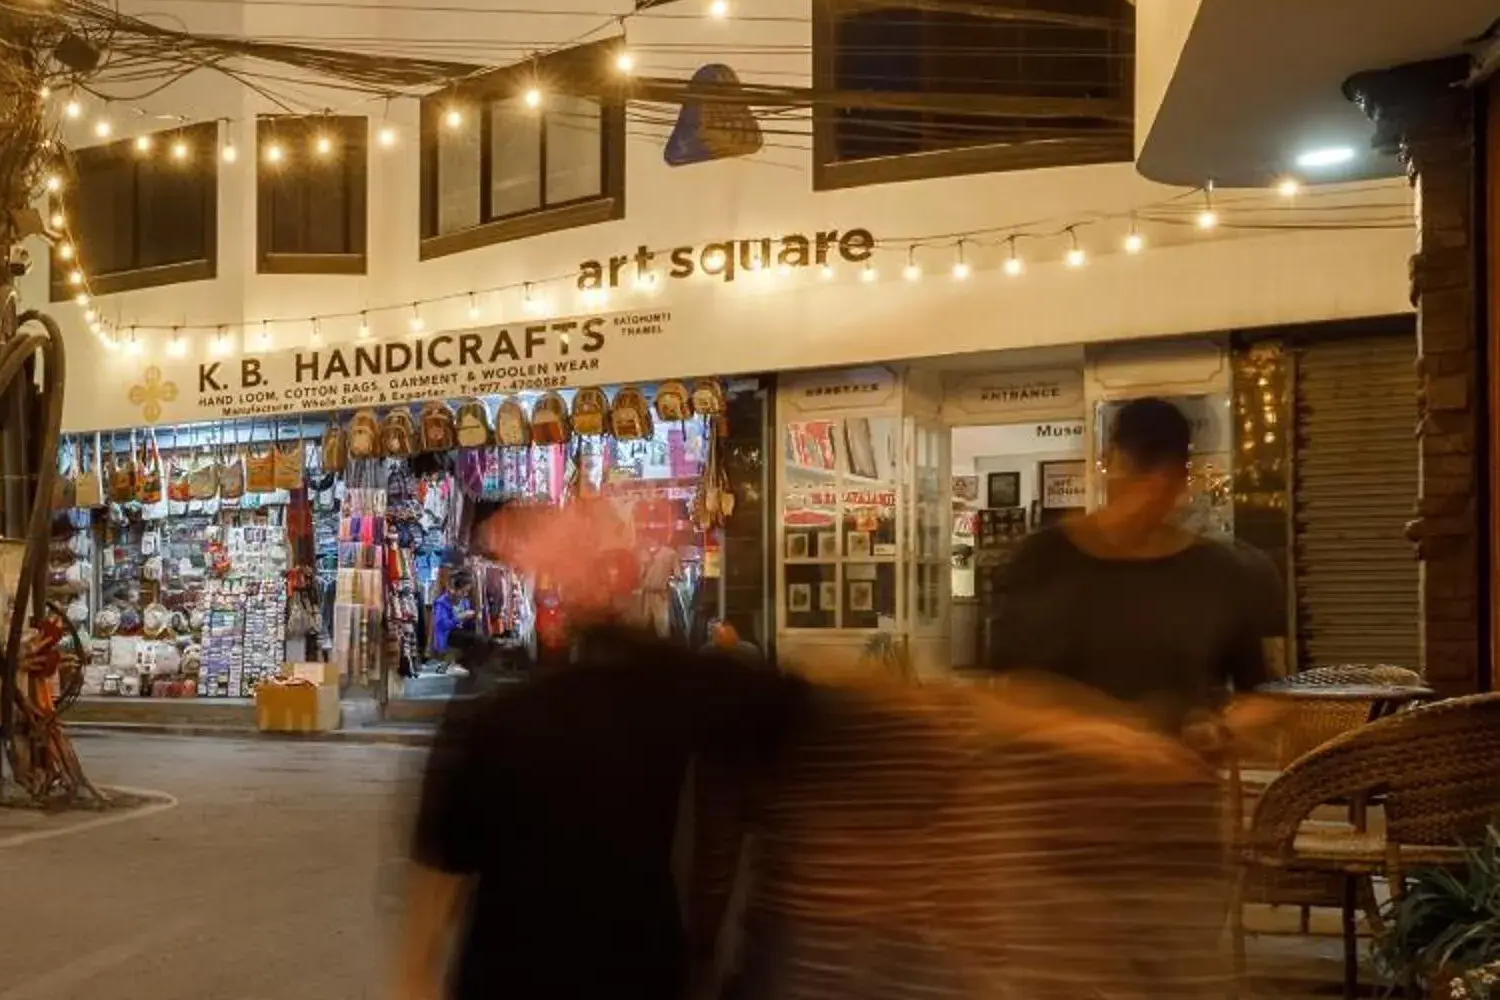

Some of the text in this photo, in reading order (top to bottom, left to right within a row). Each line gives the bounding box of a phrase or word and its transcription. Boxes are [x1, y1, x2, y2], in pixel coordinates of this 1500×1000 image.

[577, 228, 875, 291] art square
[199, 318, 606, 393] K. B. HANDICRAFTS
[199, 395, 233, 407] HAND
[284, 385, 337, 400] COTTON
[389, 373, 458, 389] GARMENT
[467, 371, 477, 382] &
[482, 363, 549, 381] WOOLEN
[555, 358, 600, 373] WEAR
